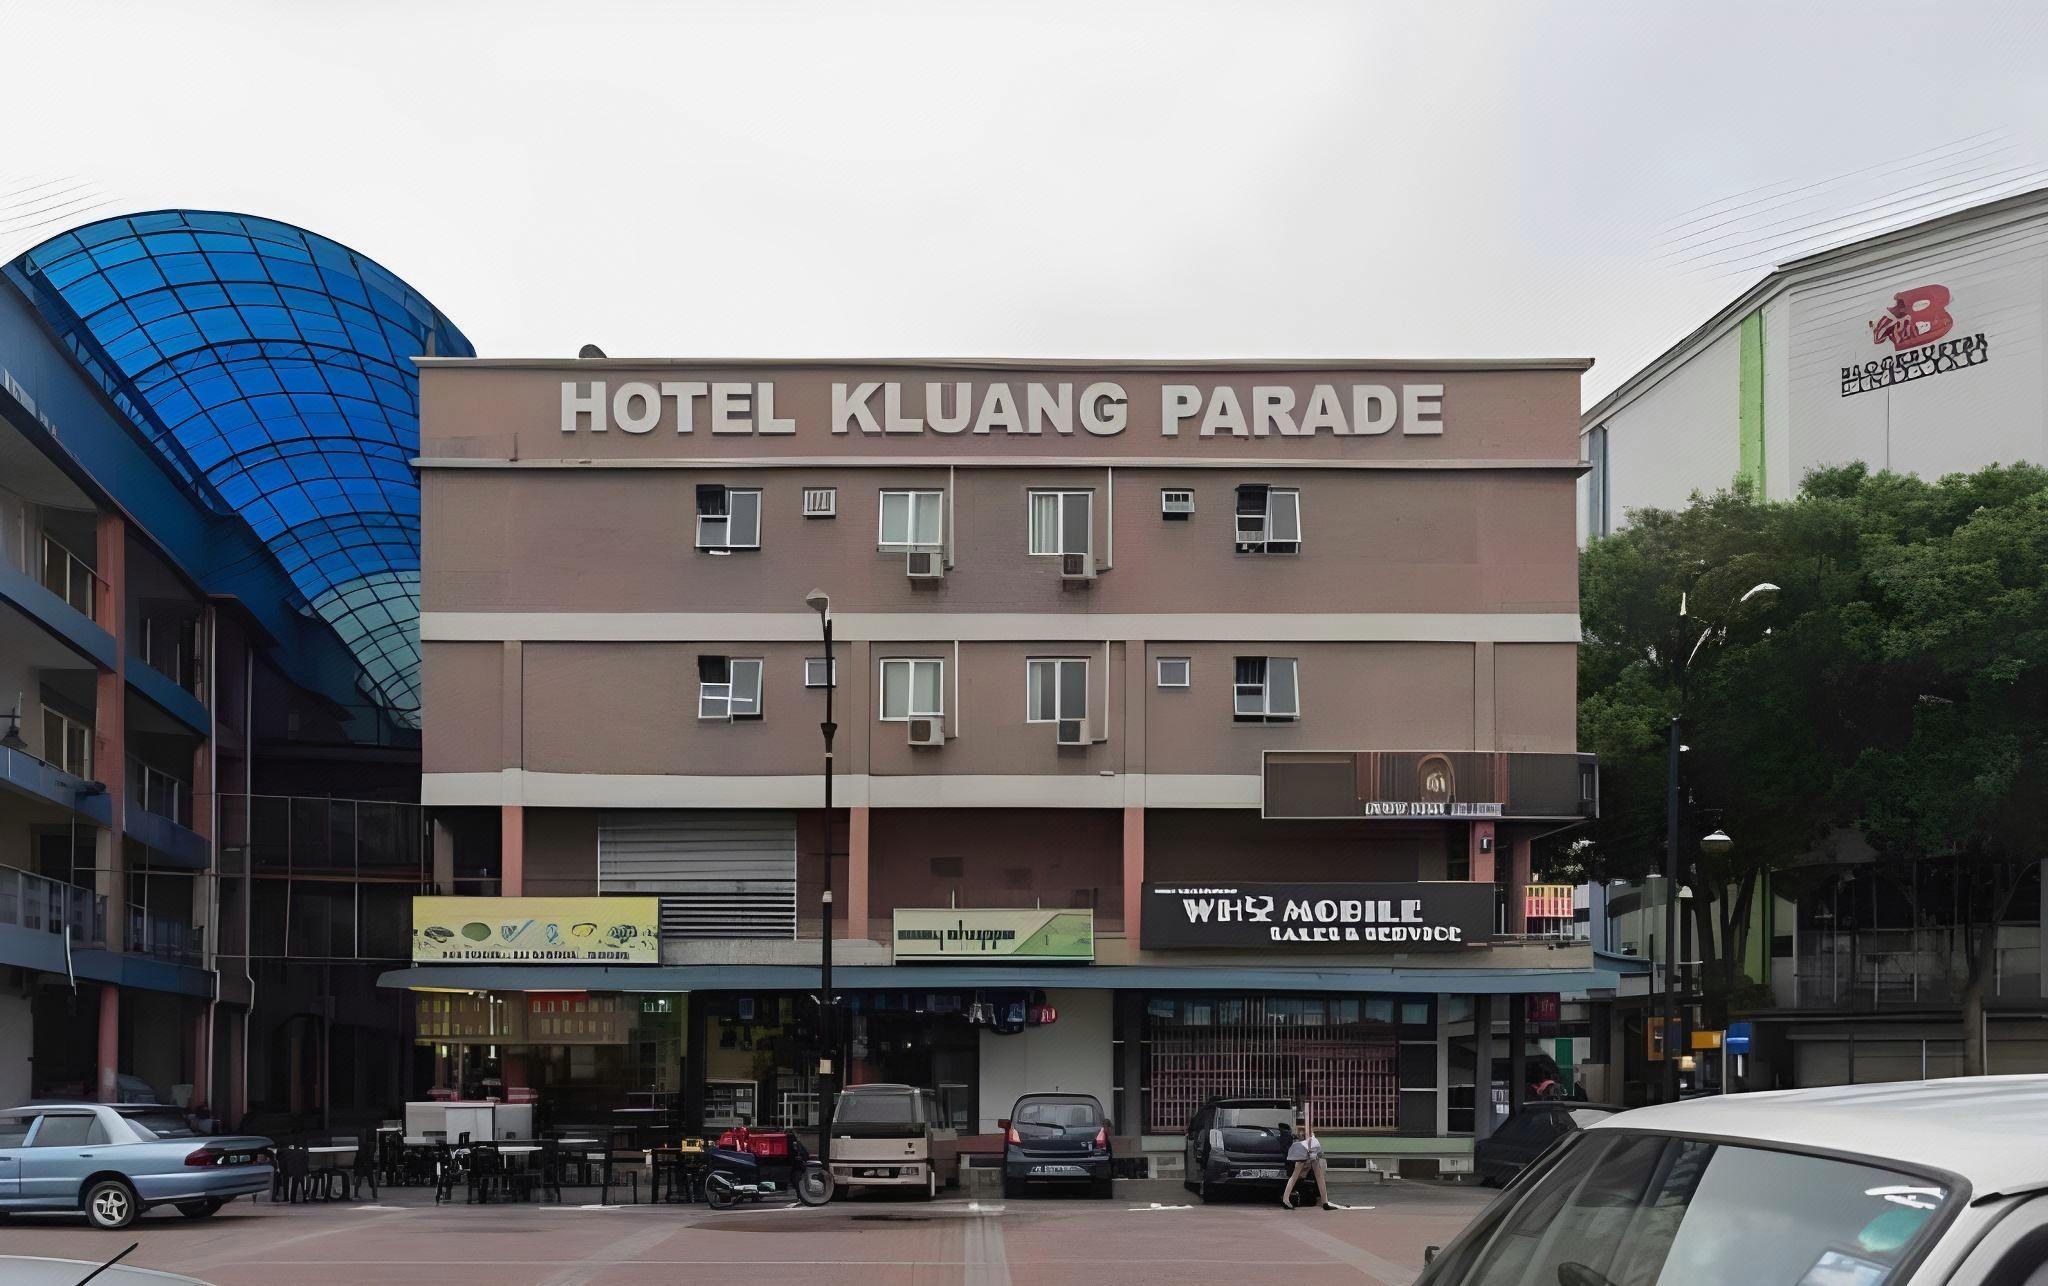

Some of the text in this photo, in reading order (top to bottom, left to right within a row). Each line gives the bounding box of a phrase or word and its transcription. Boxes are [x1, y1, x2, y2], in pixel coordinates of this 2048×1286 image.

[560, 381, 1444, 436] HOTEL KLUANG PARADE
[1282, 899, 1423, 923] MOBILE
